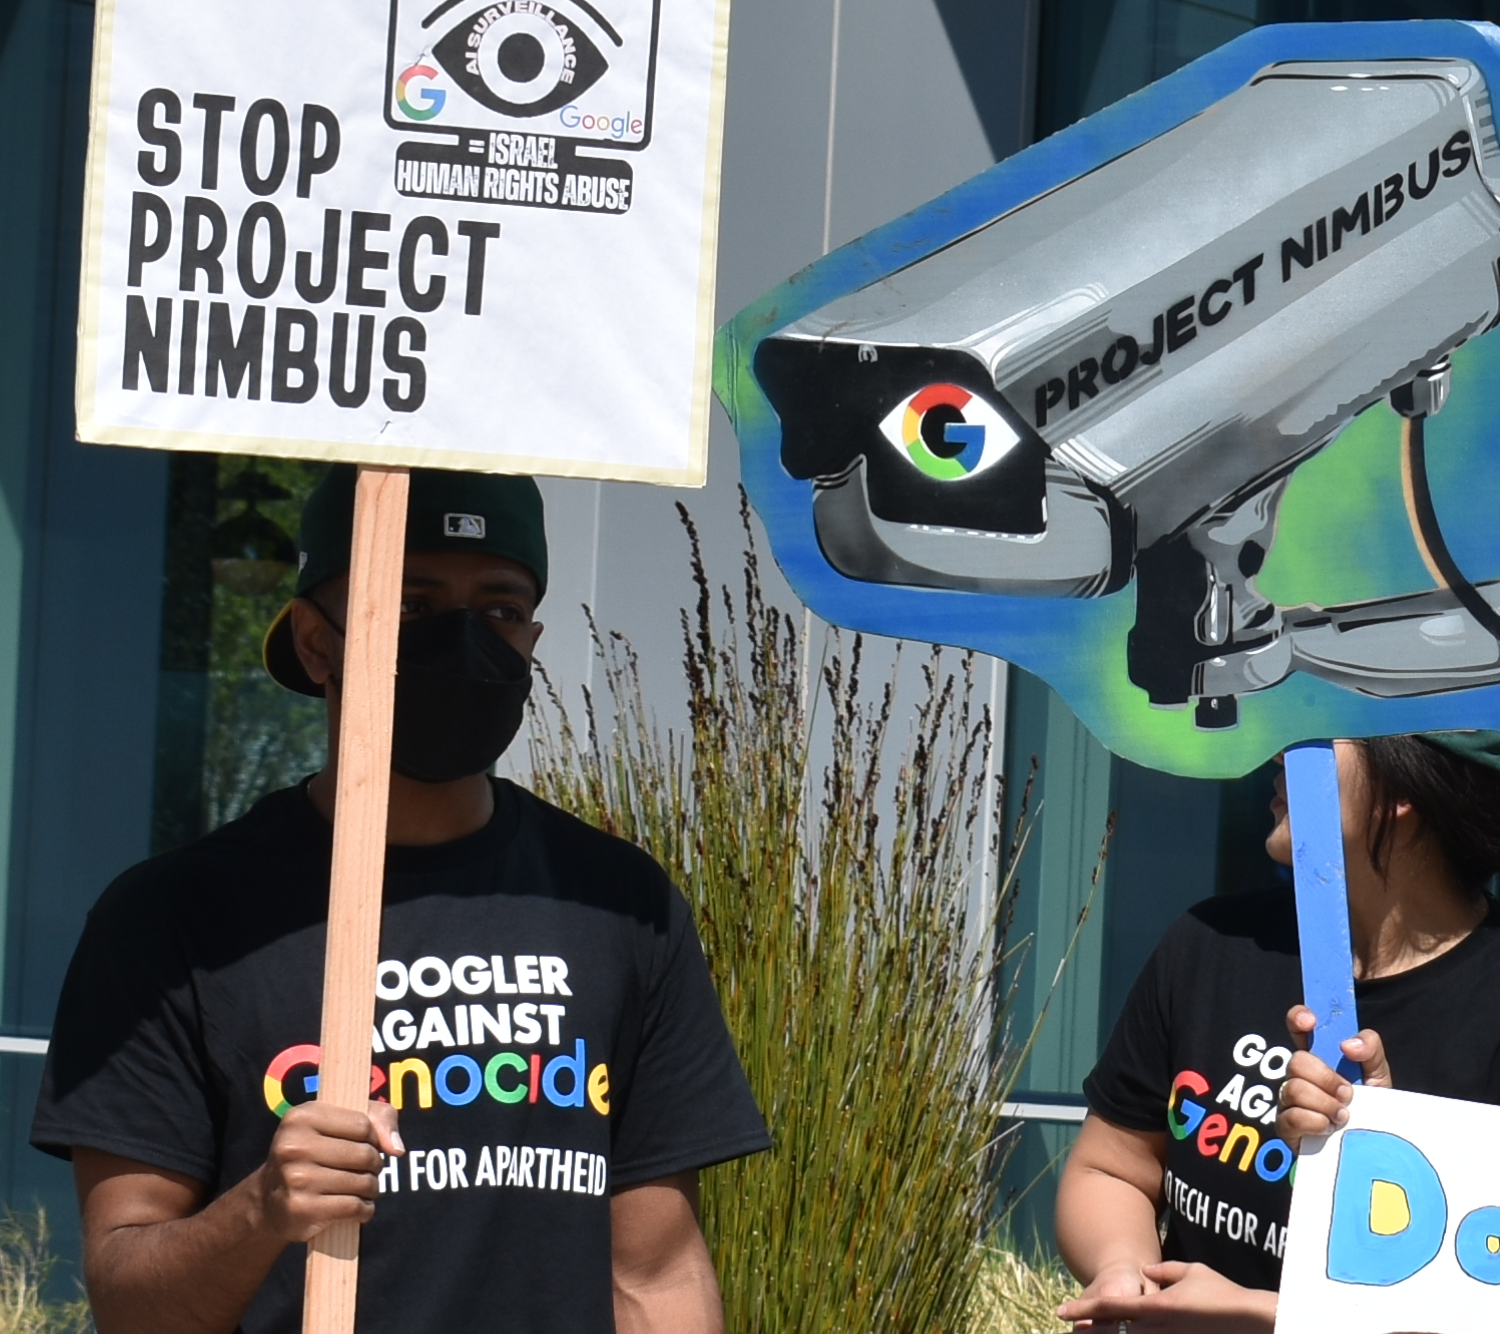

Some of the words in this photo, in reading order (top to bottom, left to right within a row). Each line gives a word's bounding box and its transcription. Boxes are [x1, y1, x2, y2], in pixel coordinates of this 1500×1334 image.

[466, 51, 480, 77] AI
[467, 0, 577, 85] SURVEILLANCE
[135, 87, 341, 200] STOP
[489, 132, 558, 170] ISRAEL
[560, 102, 643, 140] Google
[396, 159, 482, 196] HUMAN
[483, 167, 560, 205] RIGHTS
[562, 174, 632, 212] ABUSE
[128, 191, 501, 316] PROJECT
[1034, 254, 1265, 428] PROJECT
[1278, 128, 1472, 285] NIMBUS
[120, 294, 428, 413] NIMBUS
[375, 954, 574, 1002] OOGLER
[409, 1147, 471, 1192] FOR
[474, 1144, 608, 1197] APARTHEID
[1173, 1179, 1210, 1229] TECH
[1214, 1200, 1259, 1247] FOR
